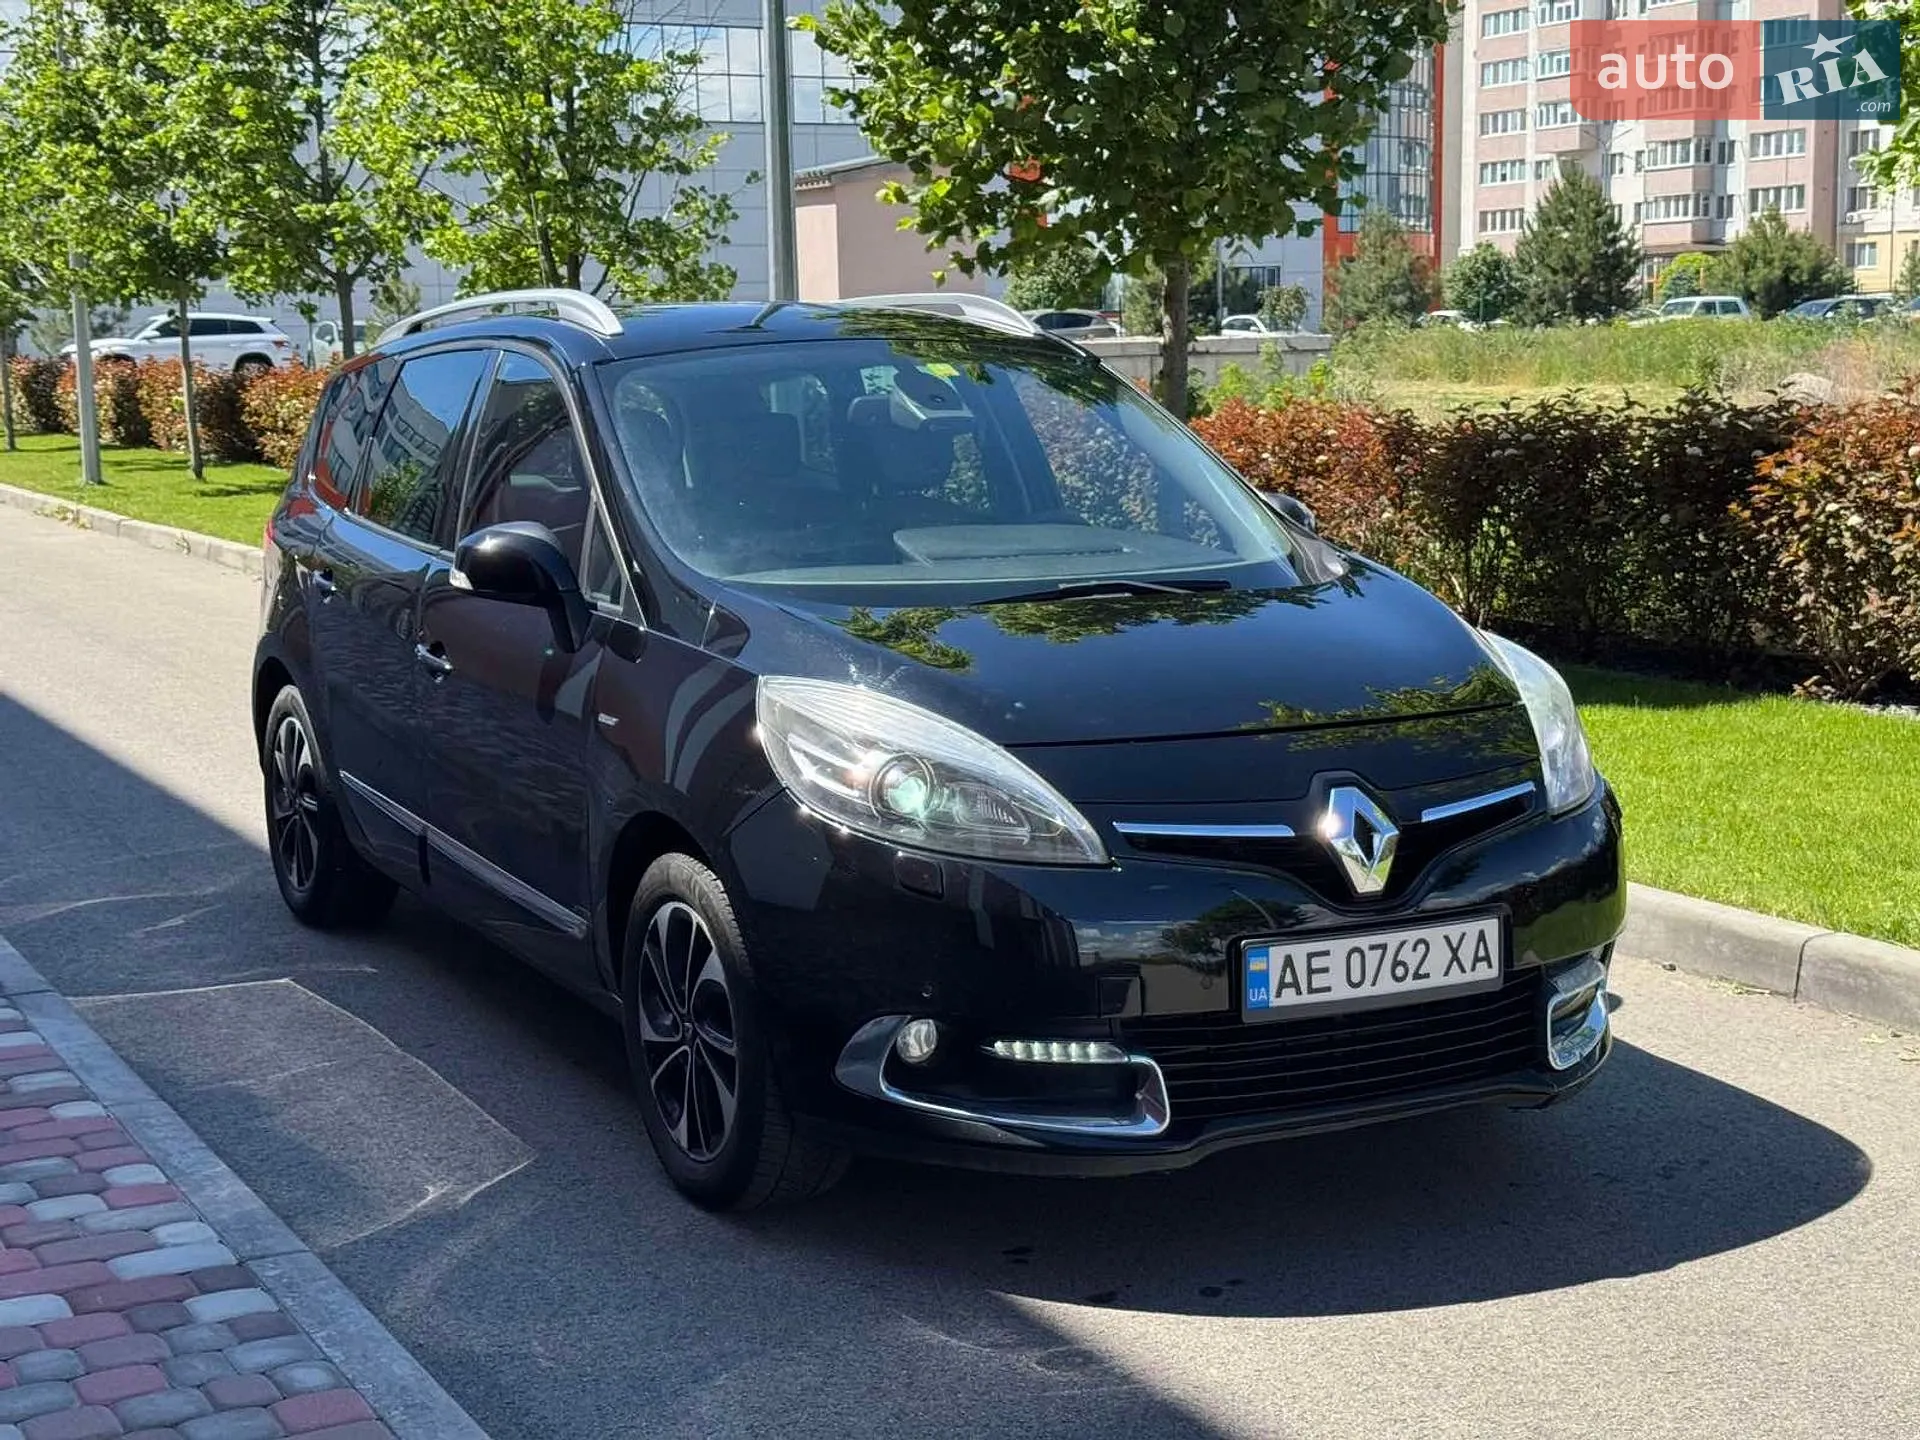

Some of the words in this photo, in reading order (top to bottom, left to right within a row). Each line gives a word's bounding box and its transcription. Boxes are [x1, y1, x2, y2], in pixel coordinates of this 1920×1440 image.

[1275, 950, 1332, 998] AE
[1345, 938, 1430, 989] 0762
[1443, 929, 1493, 977] XA
[1249, 988, 1267, 1001] UA
